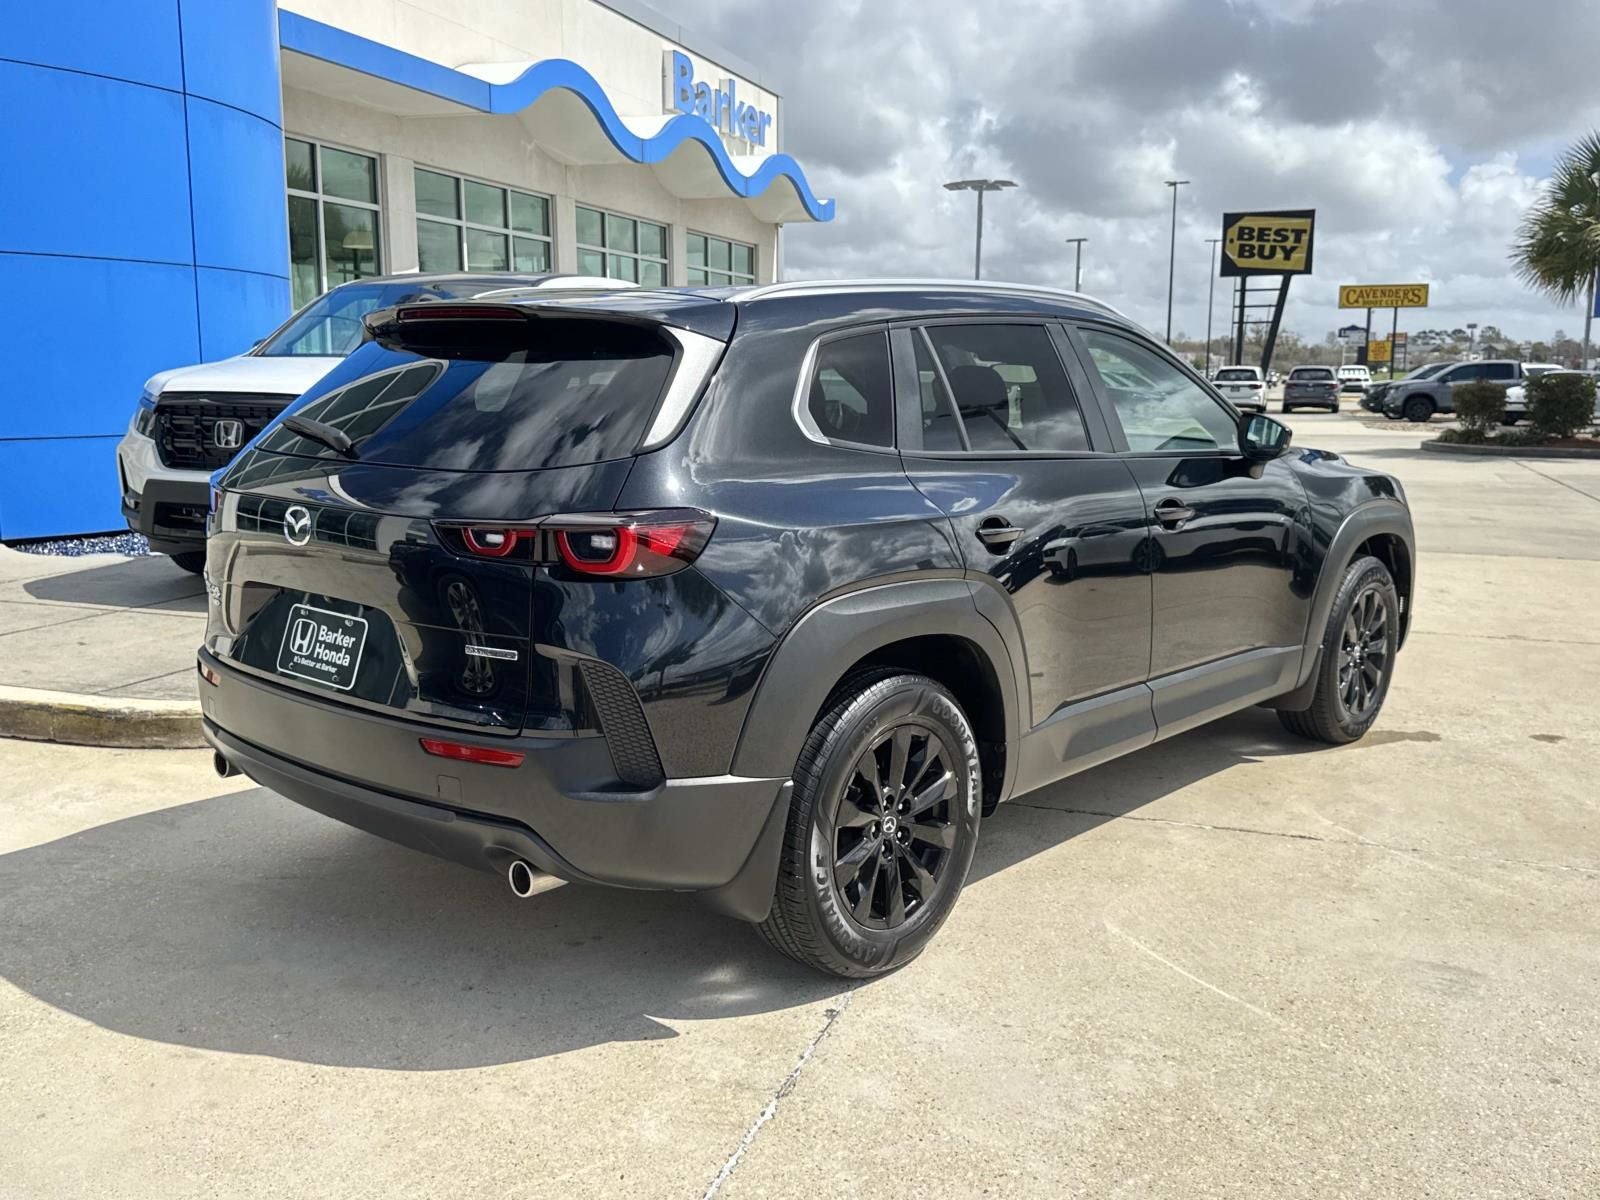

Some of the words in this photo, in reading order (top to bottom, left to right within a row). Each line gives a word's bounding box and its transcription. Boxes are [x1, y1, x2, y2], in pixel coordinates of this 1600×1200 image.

[673, 50, 772, 147] Barker
[1237, 226, 1307, 244] BEST
[1237, 243, 1299, 262] BUY
[1345, 286, 1422, 305] CAVENDER'S
[318, 625, 356, 648] Barker
[313, 642, 351, 667] Honda
